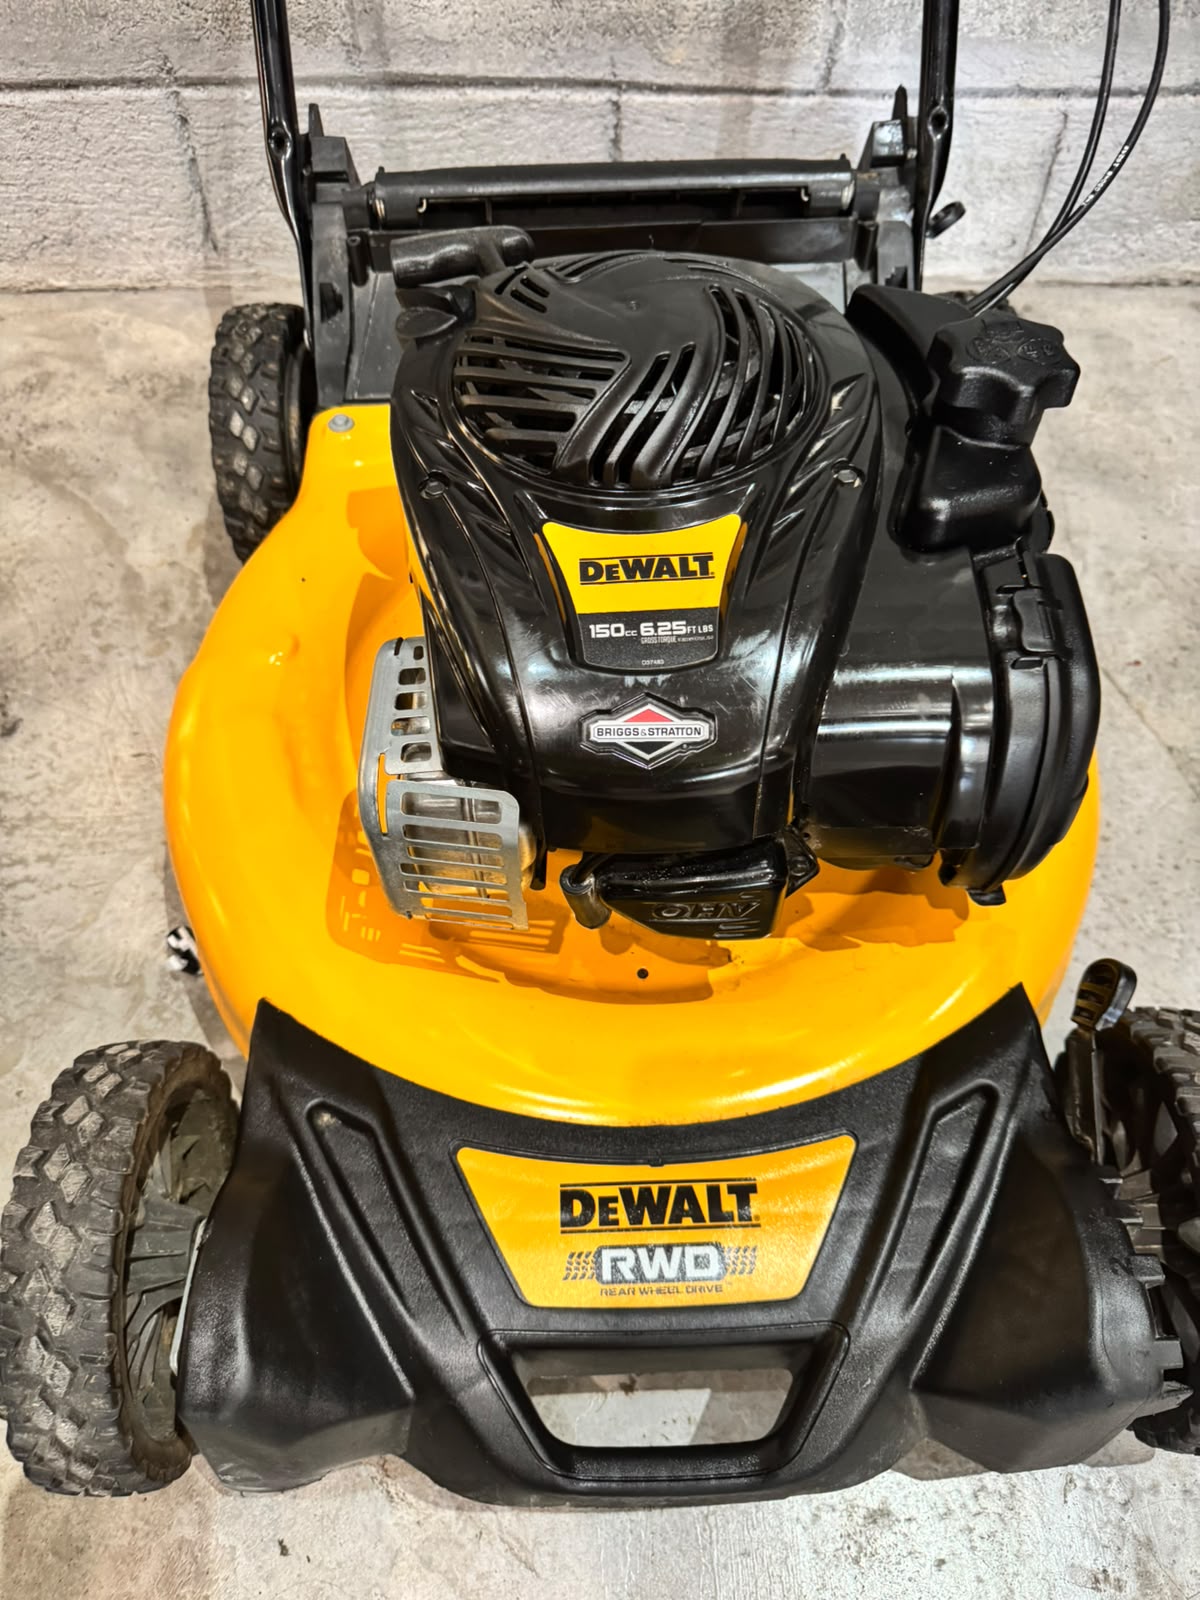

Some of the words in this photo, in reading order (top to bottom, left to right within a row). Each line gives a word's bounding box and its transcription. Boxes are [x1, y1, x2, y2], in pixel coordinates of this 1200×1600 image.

[698, 624, 713, 633] LBS
[652, 901, 761, 919] OHV
[602, 1246, 720, 1282] RWD
[600, 1287, 635, 1297] REAR
[639, 1286, 682, 1296] WHEEL
[685, 1284, 723, 1294] DRIVE
